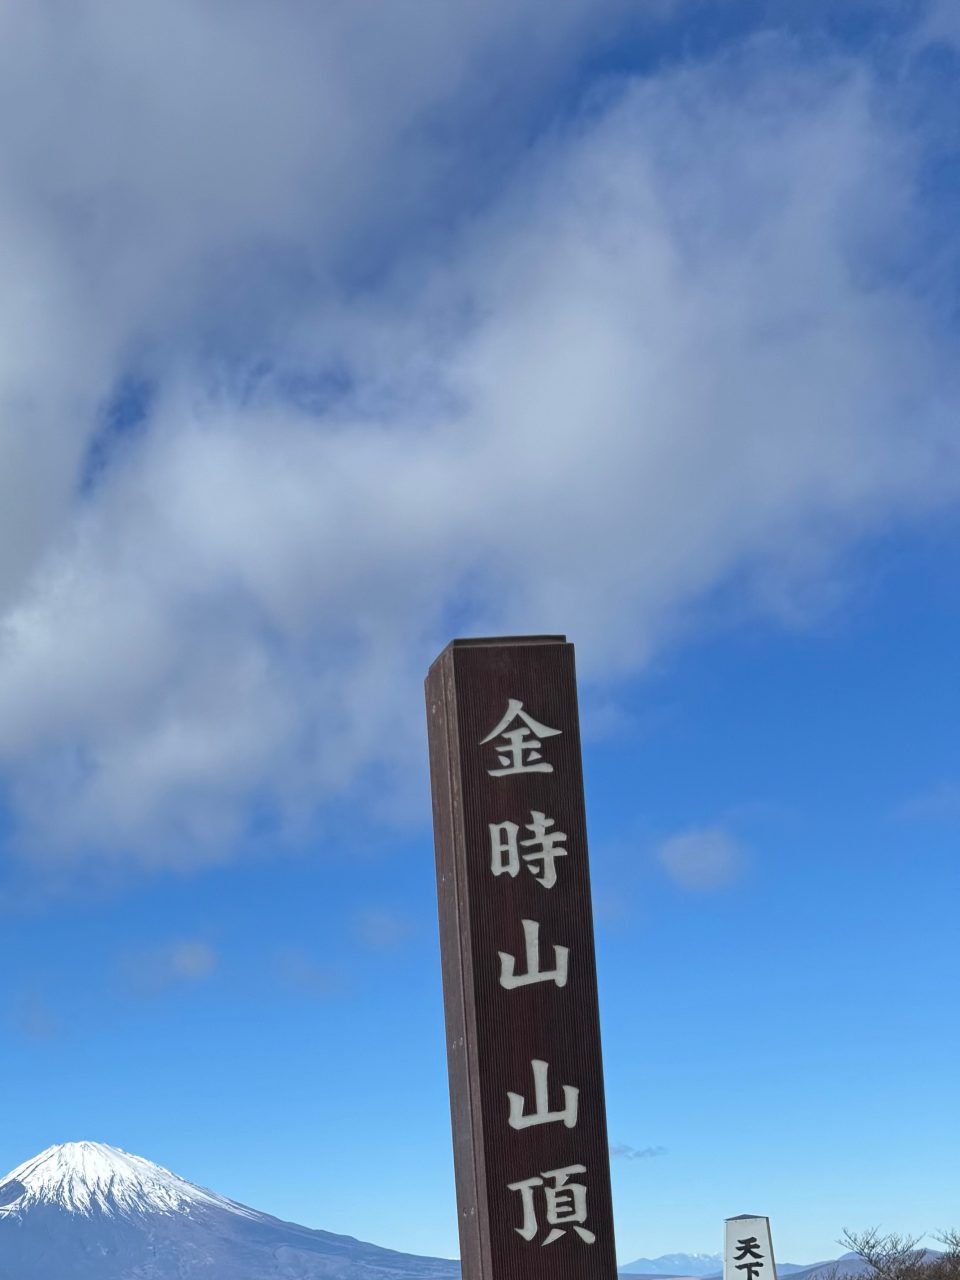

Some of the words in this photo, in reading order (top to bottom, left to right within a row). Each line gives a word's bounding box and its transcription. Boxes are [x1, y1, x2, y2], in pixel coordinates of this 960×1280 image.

[479, 699, 568, 990] 金時山
[507, 1058, 596, 1247] 山頂
